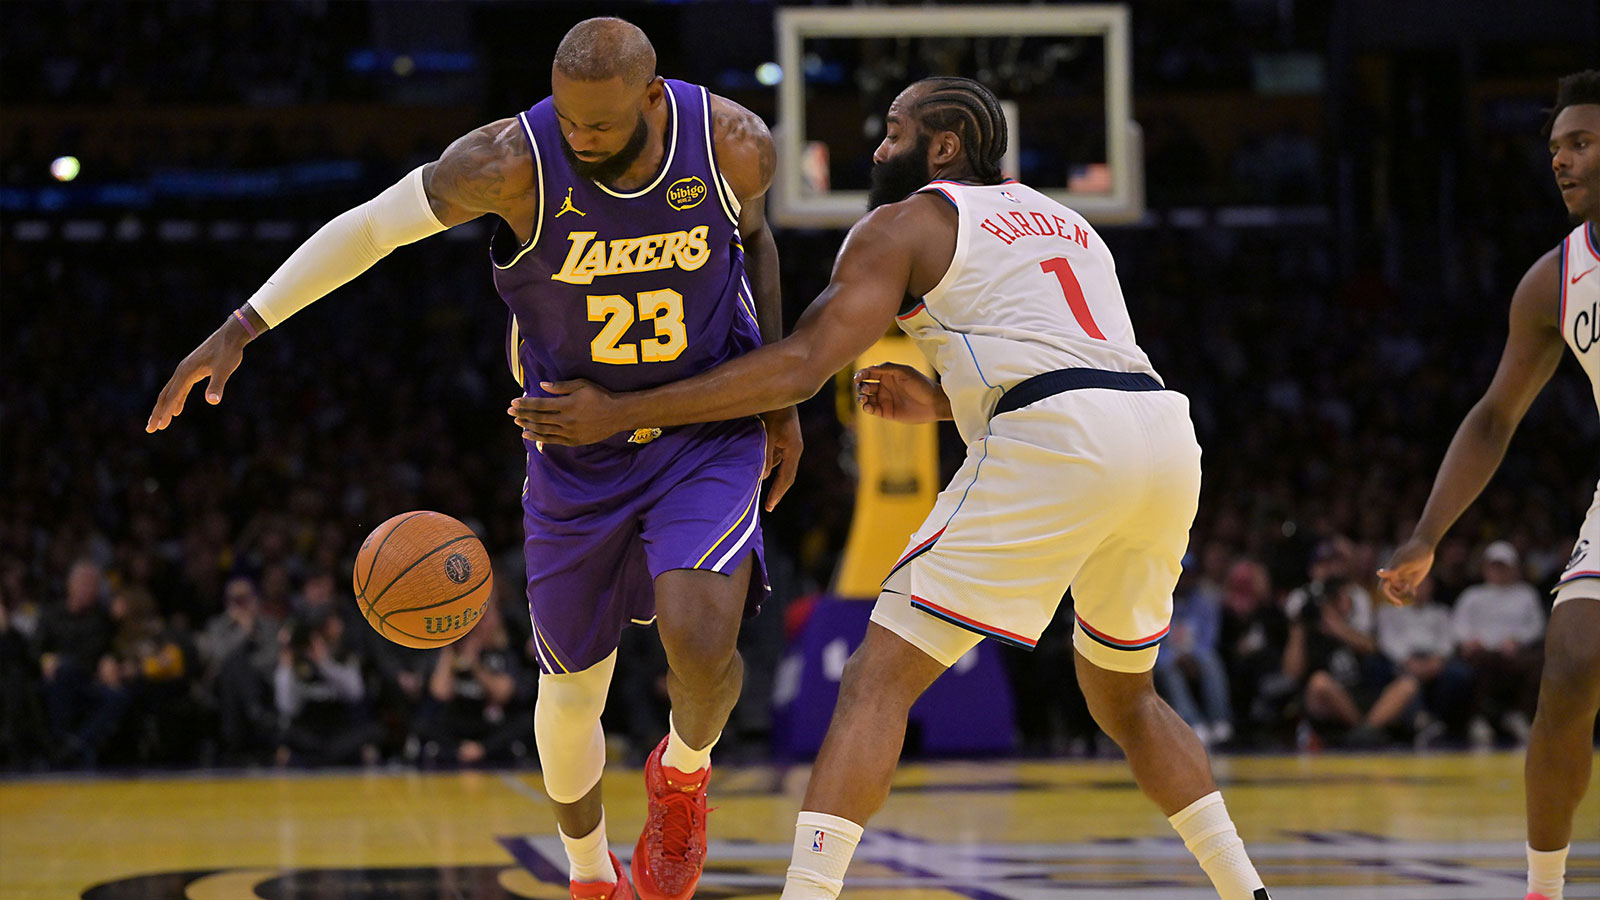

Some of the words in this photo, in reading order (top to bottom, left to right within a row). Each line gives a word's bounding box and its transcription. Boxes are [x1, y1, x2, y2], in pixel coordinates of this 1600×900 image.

[670, 185, 704, 200] bibigo
[551, 225, 711, 285] LAKERS
[980, 211, 1089, 250] HARDEN
[1039, 256, 1107, 341] 1
[586, 287, 689, 365] 23
[424, 599, 489, 634] Wilso
